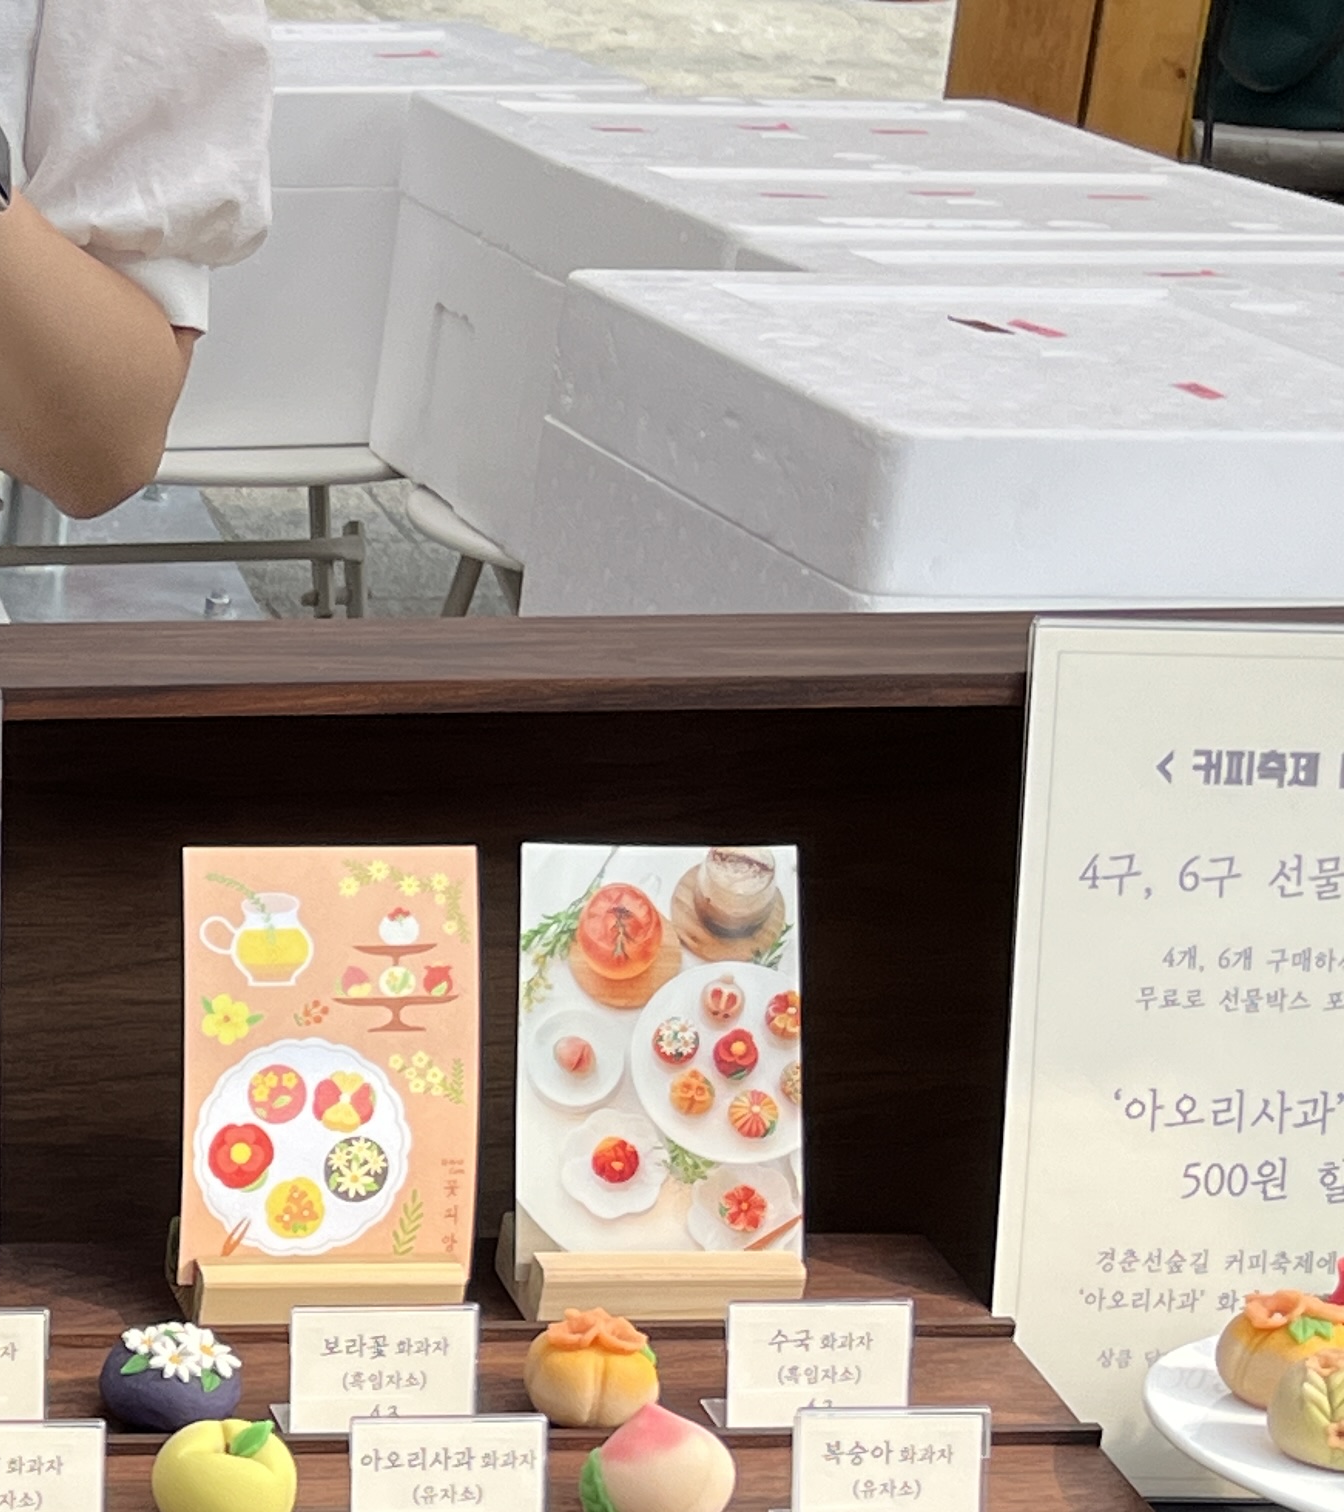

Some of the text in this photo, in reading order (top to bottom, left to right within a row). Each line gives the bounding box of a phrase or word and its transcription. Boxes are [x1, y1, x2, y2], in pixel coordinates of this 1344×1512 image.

[1192, 749, 1321, 788] 커피축제
[1079, 854, 1153, 900] 4구,
[1178, 855, 1242, 898] 6구
[1162, 945, 1253, 973] 4개, 6개
[1135, 985, 1312, 1013] 무료로 선물박스
[1181, 1157, 1288, 1201] 500원
[1096, 1248, 1209, 1275] 경춘선숲길
[1079, 1288, 1205, 1313] '아오리사과'
[320, 1334, 449, 1360] 보라꽃 화과자
[768, 1329, 874, 1352] 수국 화과자
[6, 1455, 64, 1476] 화과자
[360, 1447, 537, 1472] 아오리사과 화과자
[822, 1440, 954, 1466] 복숭아 화과자
